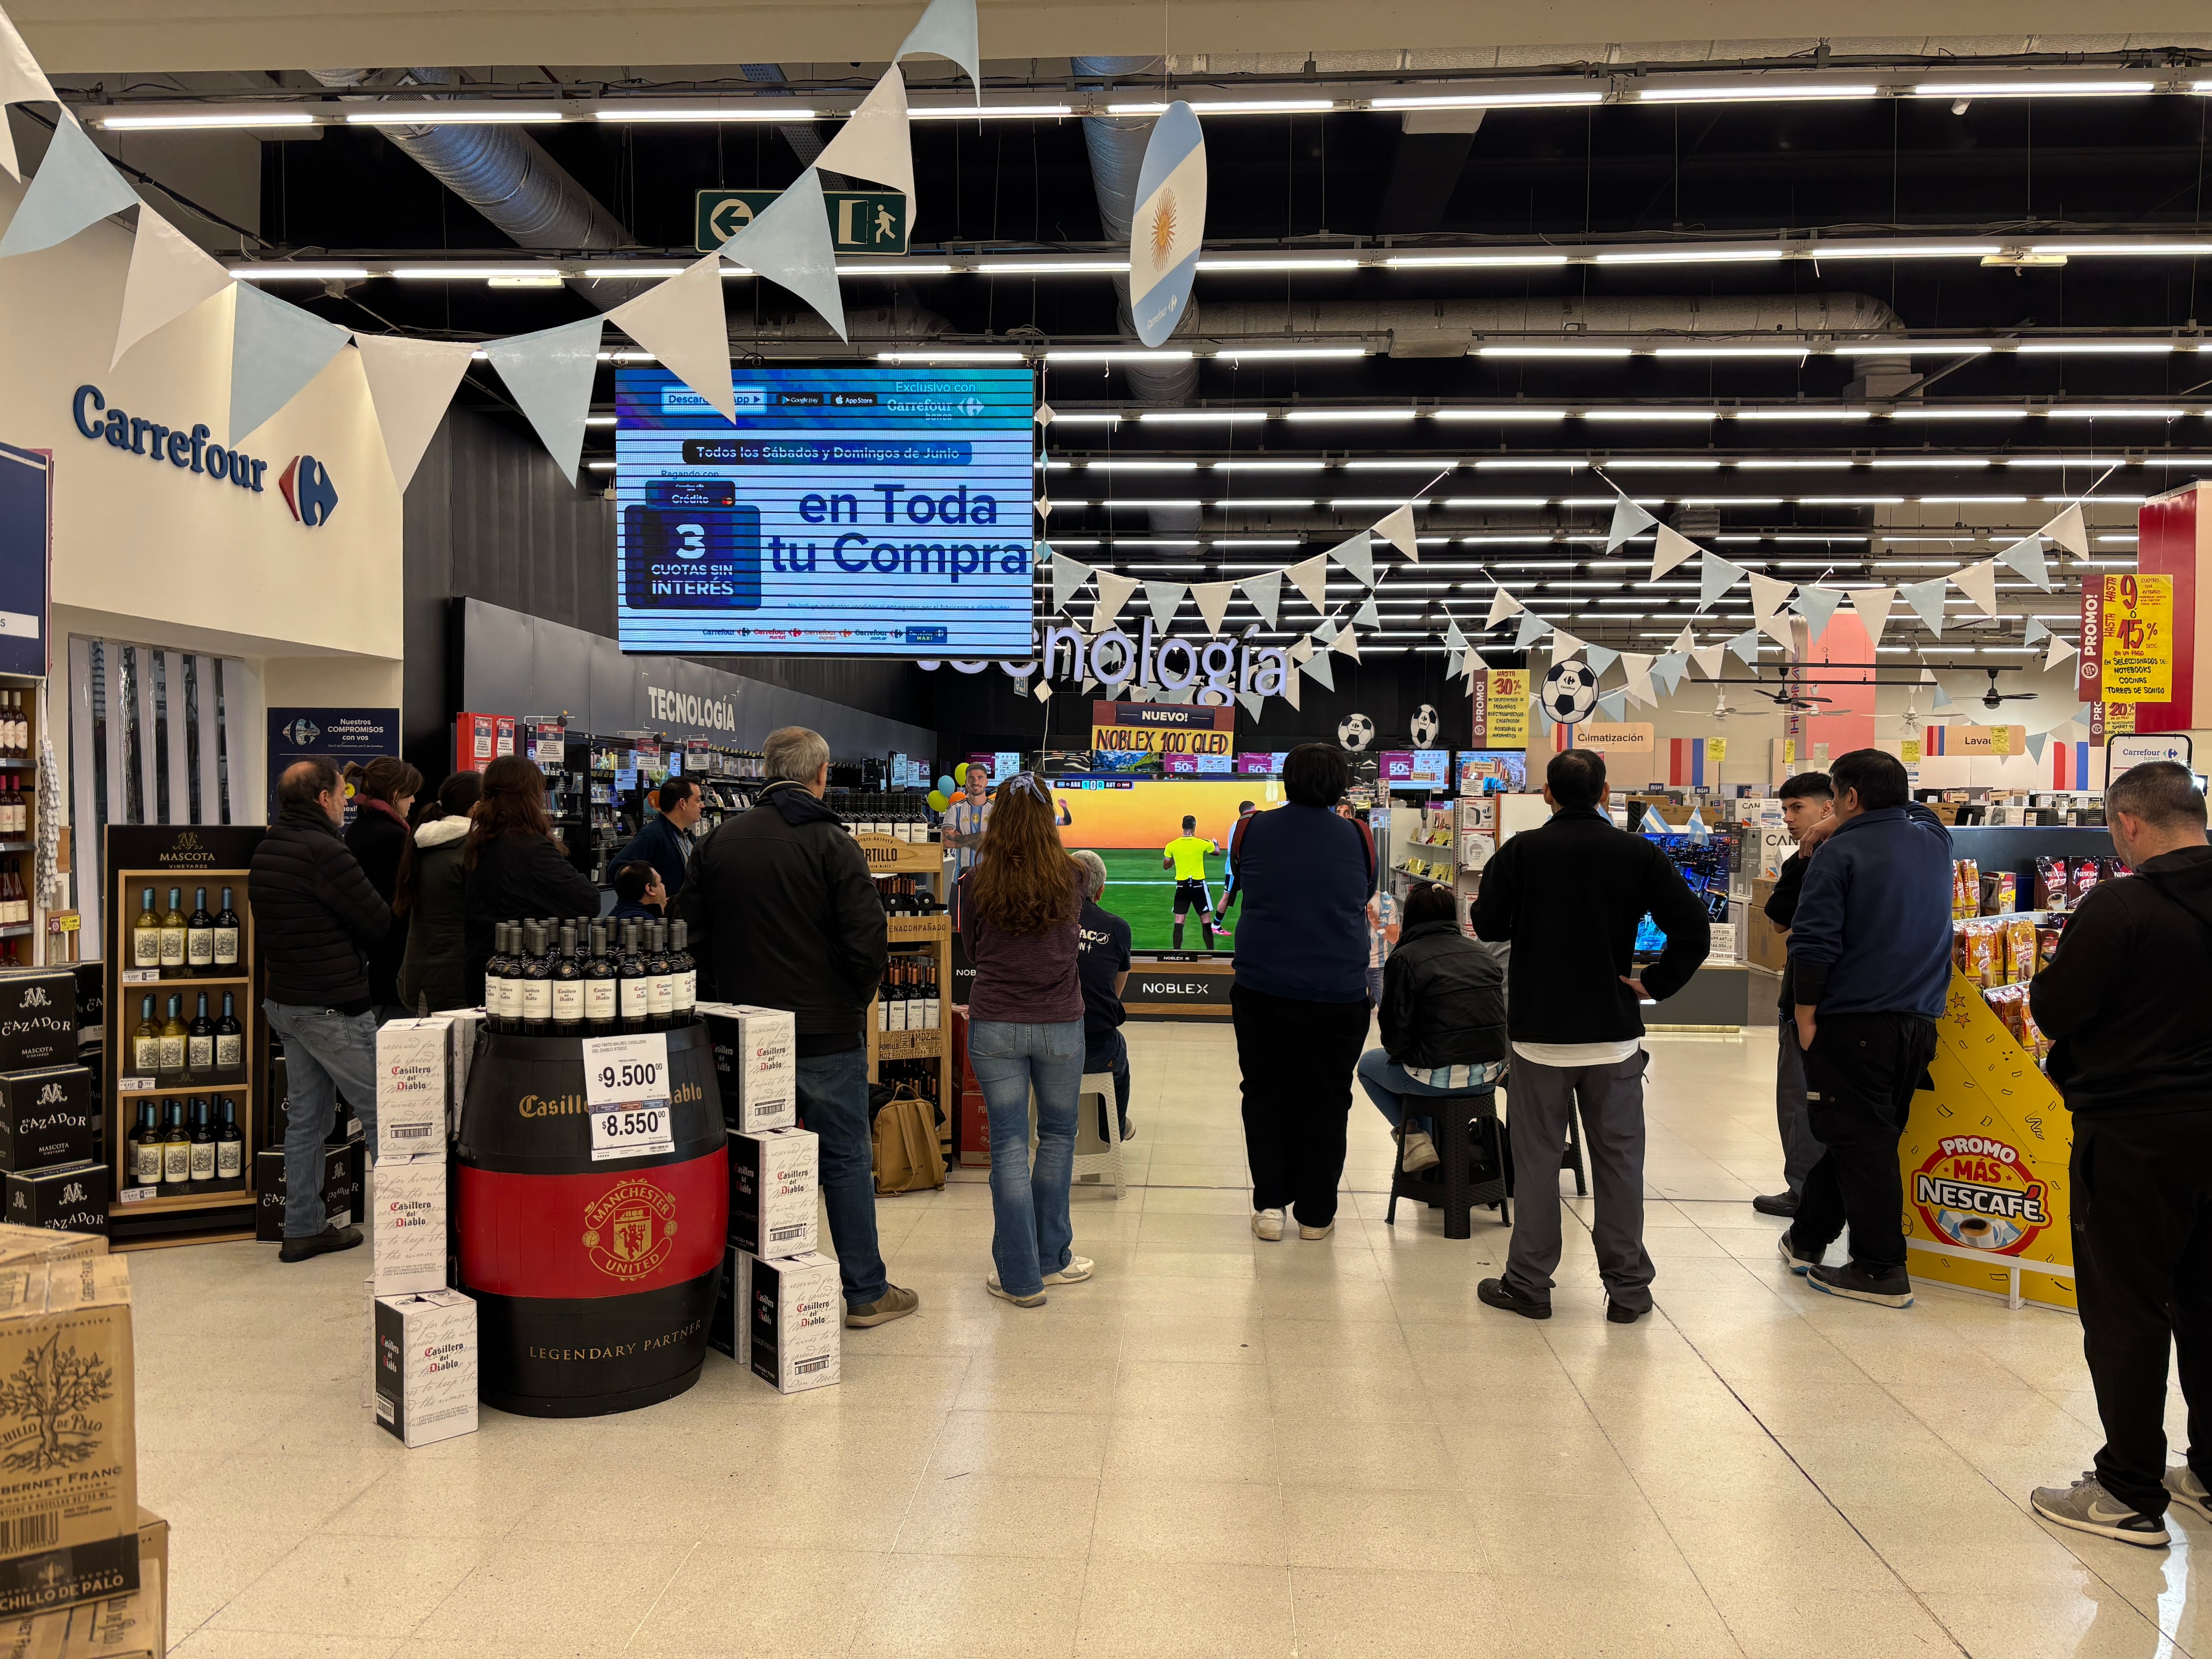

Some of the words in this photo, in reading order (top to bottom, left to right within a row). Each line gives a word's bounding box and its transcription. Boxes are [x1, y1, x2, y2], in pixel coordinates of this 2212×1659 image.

[1148, 306, 1167, 330] Carrefour
[896, 382, 950, 392] Exclusivo
[955, 383, 976, 392] con
[887, 399, 952, 411] Carrefour
[73, 384, 267, 492] Carrefour
[697, 446, 736, 457] Todos
[741, 447, 758, 457] los
[763, 446, 818, 458] Sábados
[822, 449, 829, 461] y
[834, 447, 899, 461] Domingos
[904, 447, 920, 458] de
[924, 448, 960, 459] Junio
[661, 471, 699, 479] Pagando
[672, 495, 709, 504] Crédito
[799, 493, 858, 523] en
[875, 484, 997, 524] Toda
[676, 524, 705, 559] 3
[768, 536, 815, 572] tu
[834, 533, 1027, 583] Compra
[652, 565, 706, 575] CUOTAS
[710, 565, 733, 575] SIN
[652, 576, 733, 595] INTERÉS
[2104, 577, 2116, 602] HASTA
[2120, 575, 2137, 609] 9
[2084, 594, 2098, 656] PROMO!
[2103, 614, 2116, 637] HASTA
[649, 686, 735, 732] TECNOLOGÍA
[1476, 681, 1484, 722] PROMO!
[1142, 711, 1188, 722] NUEVO!
[1095, 729, 1155, 752] NOBLEX
[1191, 733, 1228, 754] QLED
[1175, 762, 1193, 772] 50%
[1143, 983, 1208, 994] NOBLEX
[2, 1017, 70, 1036] CAZADOR
[915, 1033, 930, 1041] MDZ
[757, 1048, 785, 1056] Casillero
[392, 1066, 430, 1075] Casillero
[397, 1082, 426, 1090] Diablo
[20, 1113, 86, 1134] CAZADOR
[39, 1143, 69, 1152] MASCOTA
[1942, 1138, 2016, 1163] PROMO
[778, 1170, 808, 1179] Casillero
[1954, 1158, 2001, 1183] MÁS
[781, 1186, 804, 1194] Diablo
[391, 1202, 430, 1211] Casillero
[593, 1187, 669, 1222] MANCHESTER
[1920, 1177, 2041, 1220] NESCAFÉ
[396, 1217, 425, 1227] Diablo
[606, 1254, 659, 1273] UNITED
[757, 1290, 773, 1307] Casillero
[797, 1301, 829, 1312] Casillero
[758, 1310, 771, 1325] Diablo
[801, 1317, 825, 1327] Diablo
[530, 1343, 637, 1359] LEGENDARY
[644, 1319, 701, 1351] PARTNER
[425, 1343, 463, 1357] Casillero
[430, 1359, 458, 1373] Diablo
[69, 1467, 122, 1483] FRANC
[59, 1584, 79, 1598] DE
[82, 1575, 124, 1594] PALO
